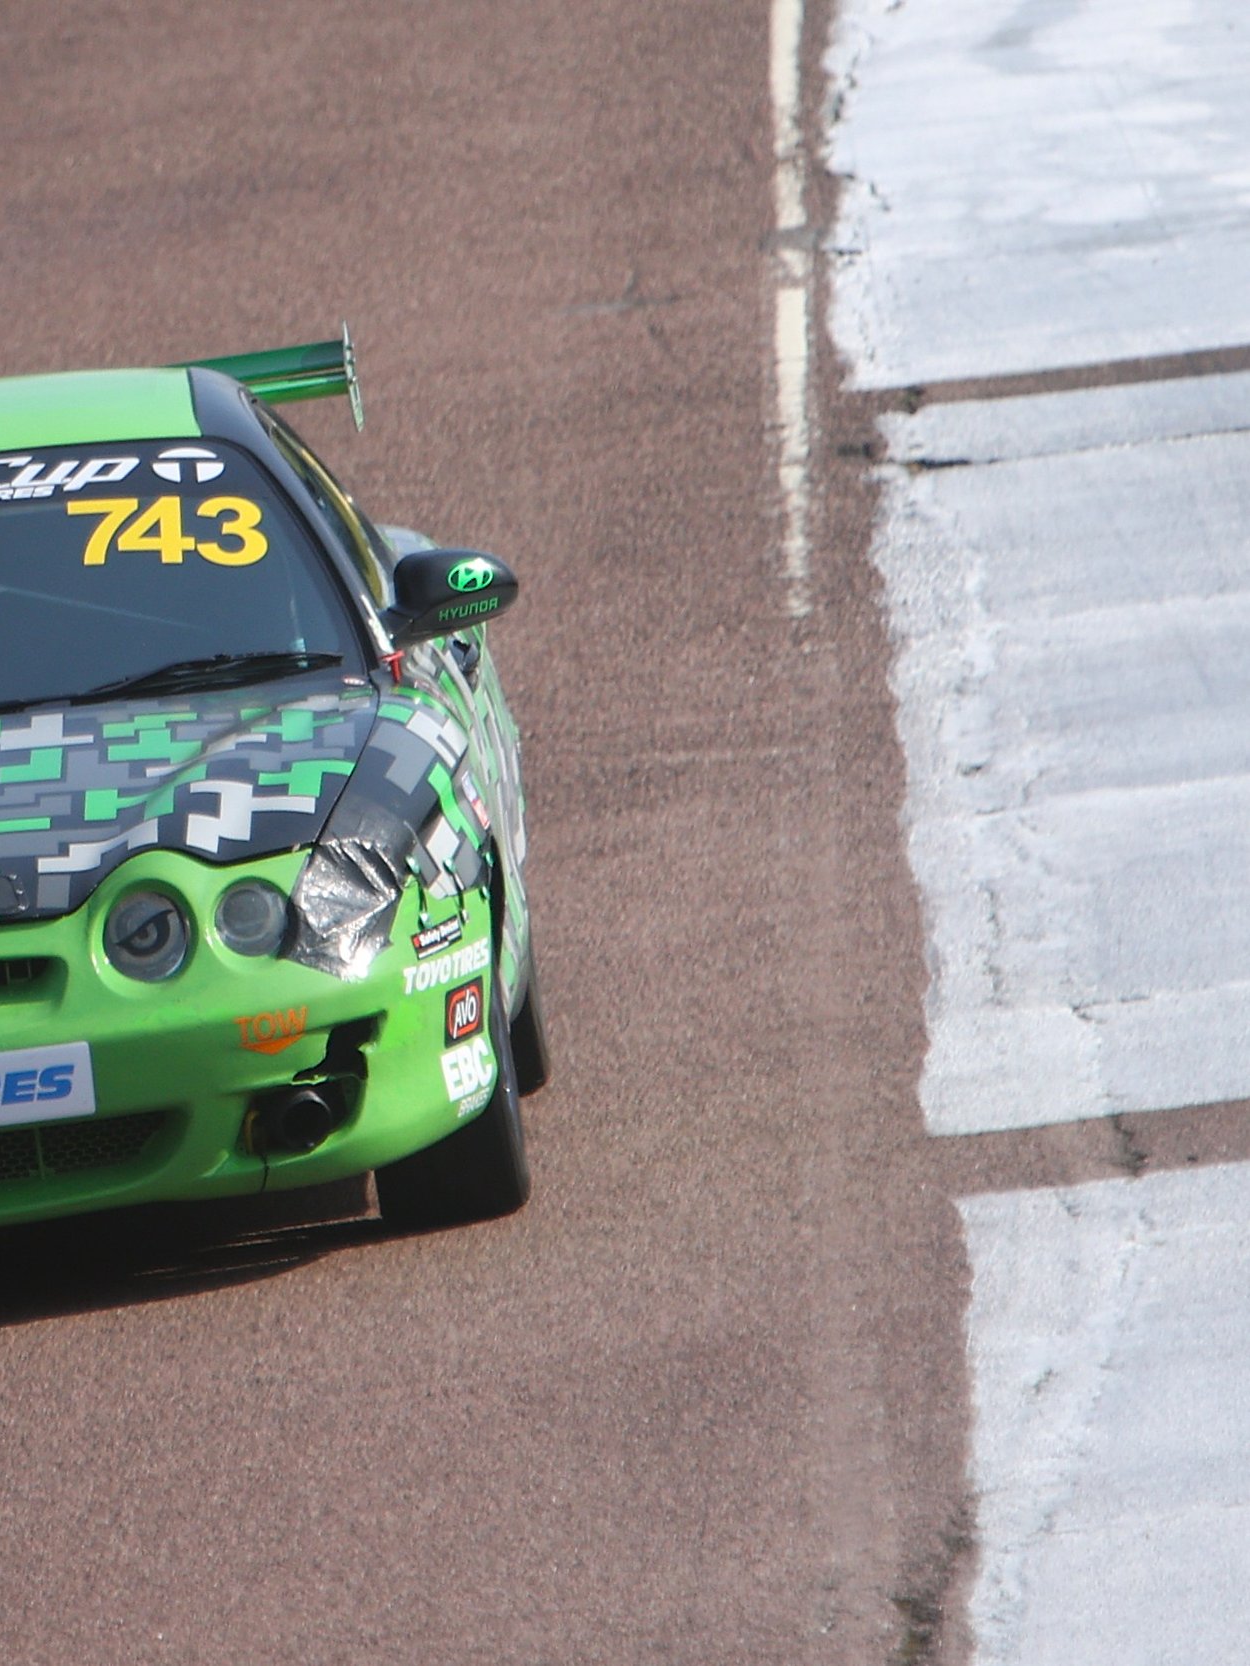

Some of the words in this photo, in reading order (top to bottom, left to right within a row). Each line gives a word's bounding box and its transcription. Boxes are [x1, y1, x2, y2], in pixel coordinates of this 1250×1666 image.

[66, 495, 268, 567] 743
[403, 954, 452, 995] TOYO
[452, 937, 490, 979] TIRES
[233, 1005, 308, 1046] TOW
[453, 988, 477, 1039] AVO
[440, 1038, 492, 1102] EBC
